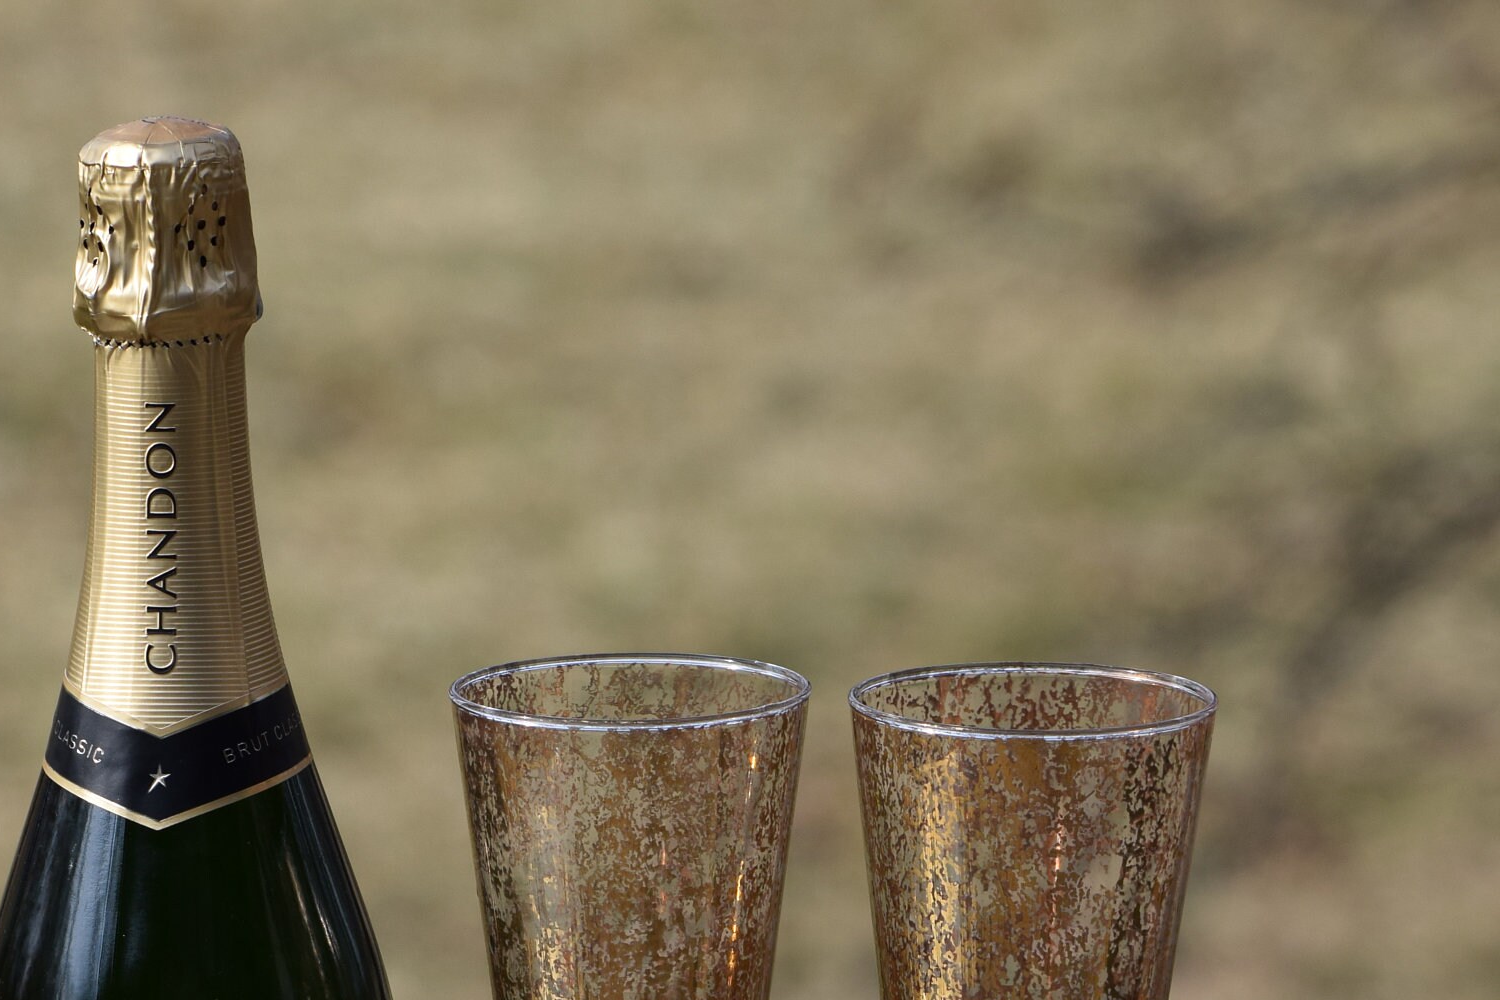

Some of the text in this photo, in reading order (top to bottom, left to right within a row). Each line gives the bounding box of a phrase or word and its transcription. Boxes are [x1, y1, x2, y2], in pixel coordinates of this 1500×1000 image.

[145, 401, 177, 675] CHANDON
[54, 719, 105, 764] CLASSIC
[223, 731, 268, 764] BRUT
